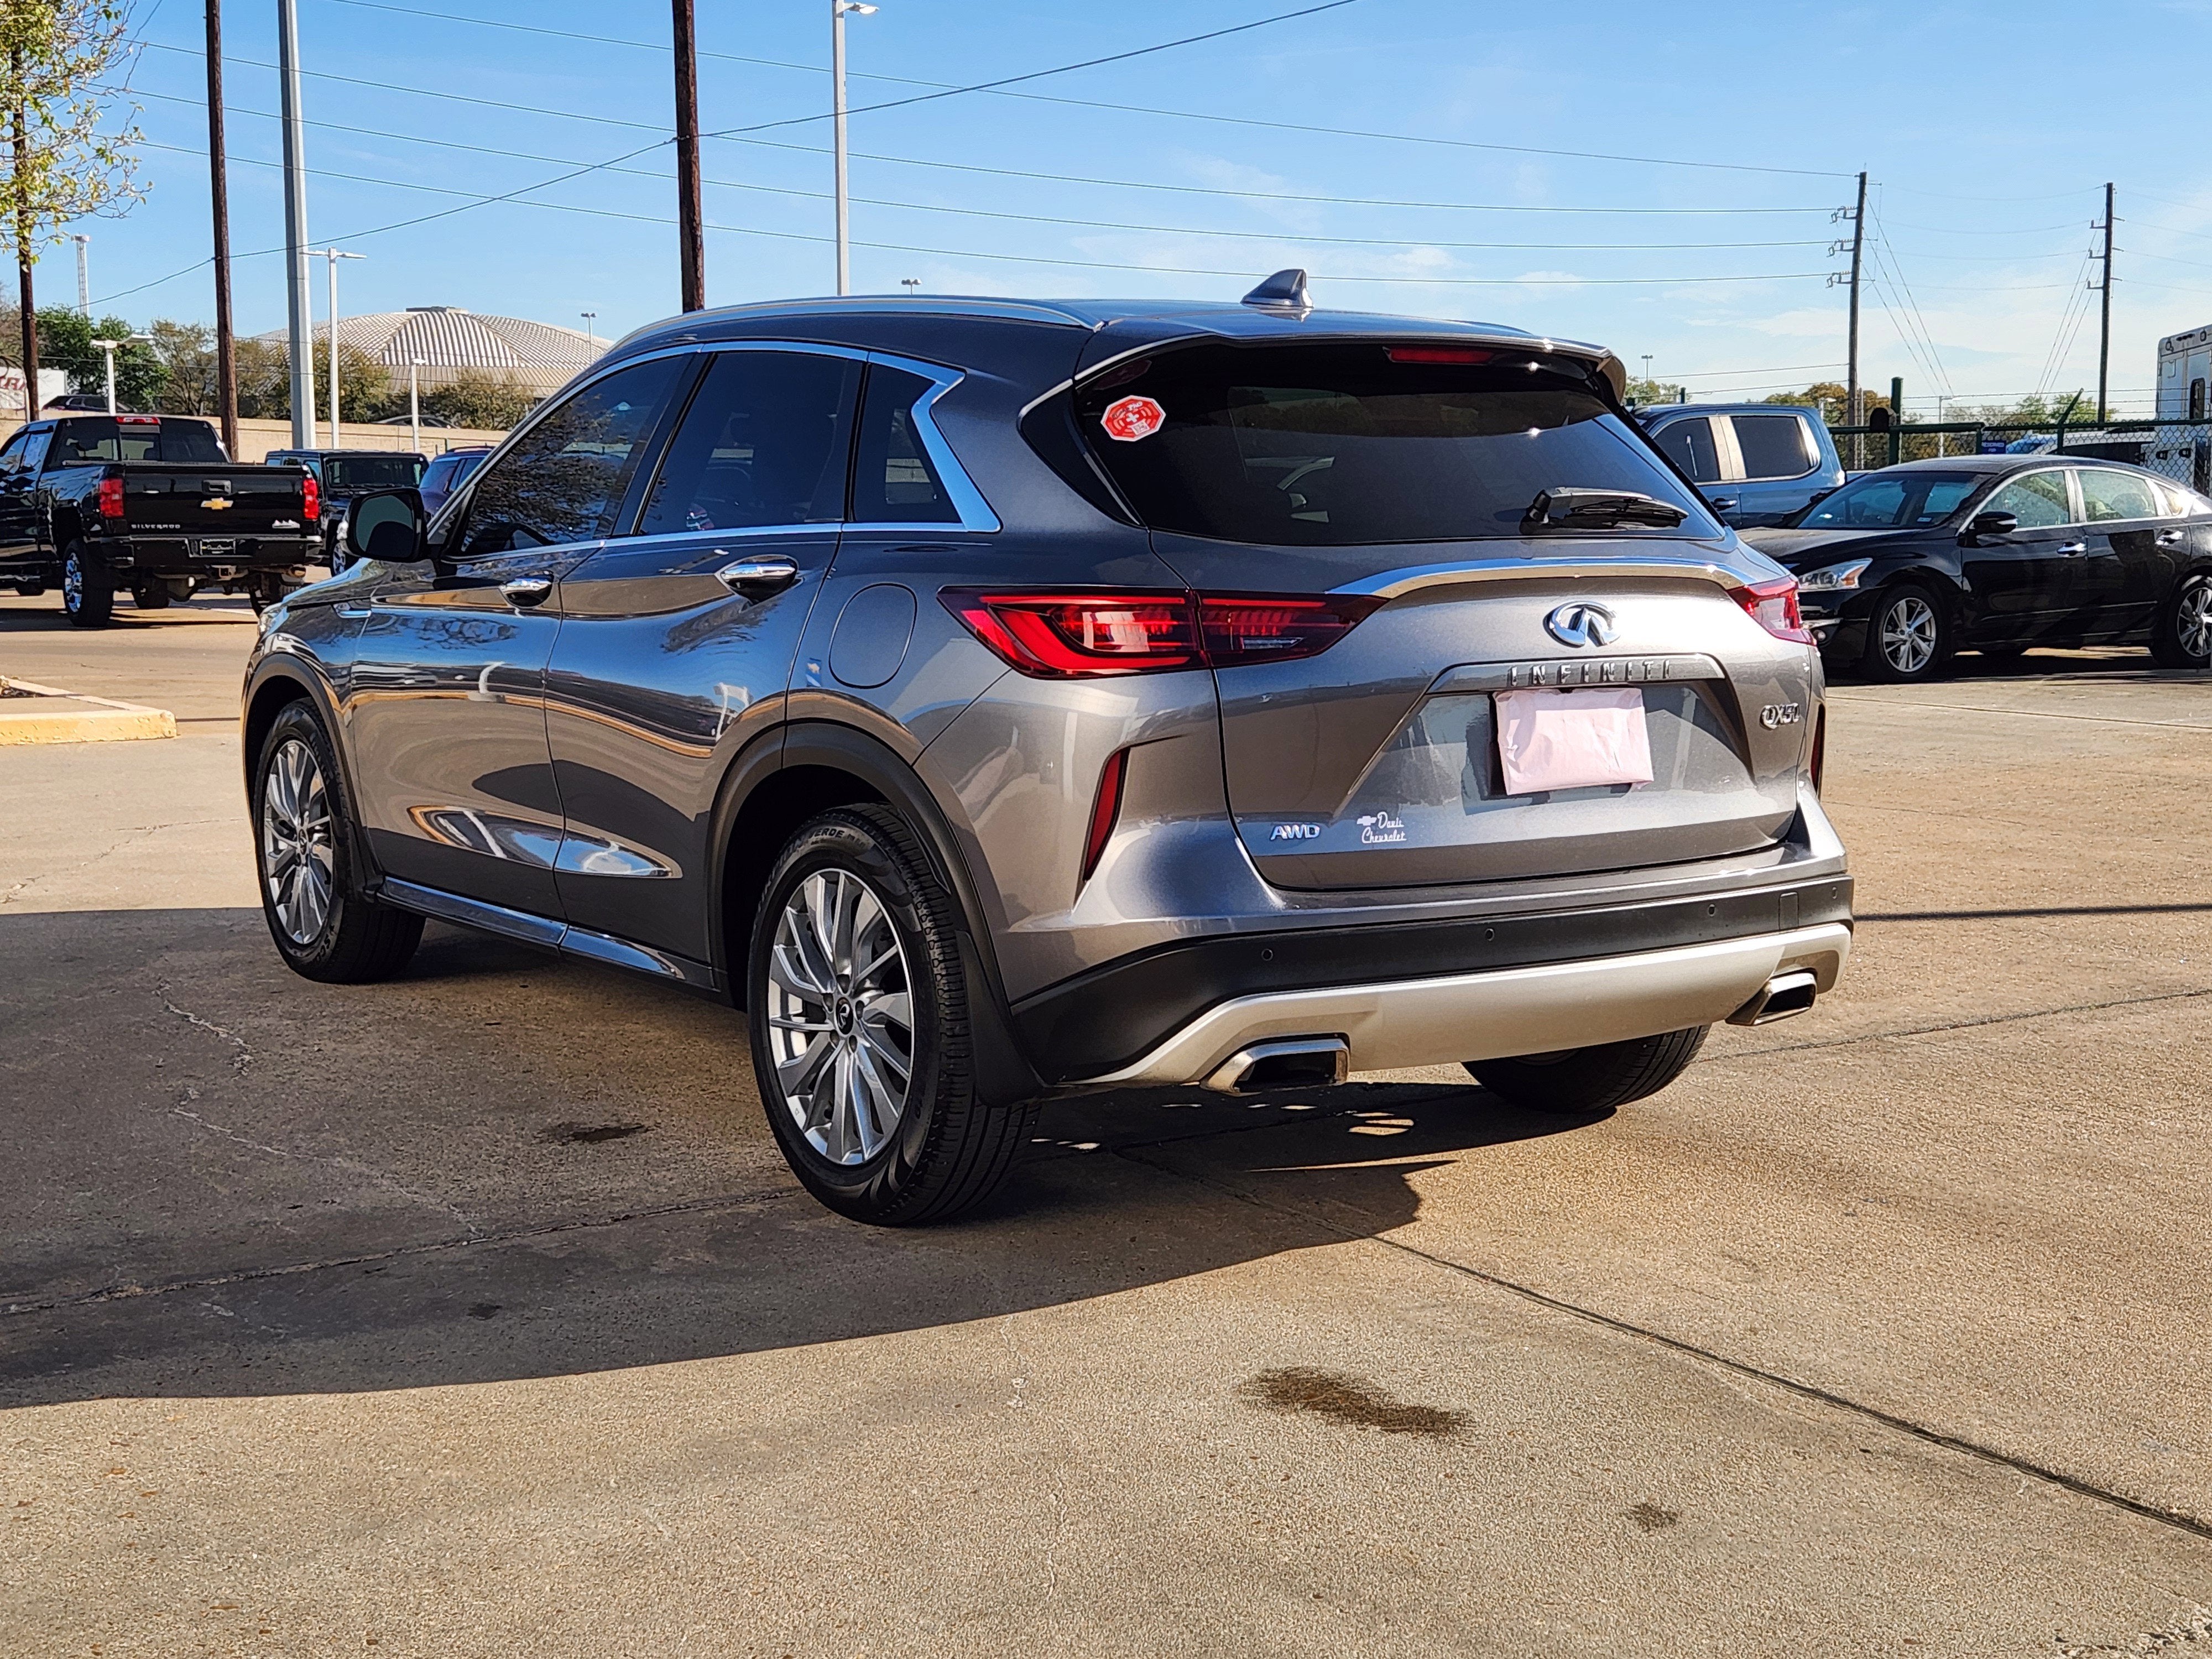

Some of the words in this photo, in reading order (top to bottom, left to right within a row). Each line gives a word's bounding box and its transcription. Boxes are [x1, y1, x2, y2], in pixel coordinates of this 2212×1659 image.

[1508, 660, 1670, 687] INFINITI
[1760, 703, 1800, 731] QX50
[1270, 824, 1320, 841] AWD
[1361, 827, 1407, 844] Chevrolet
